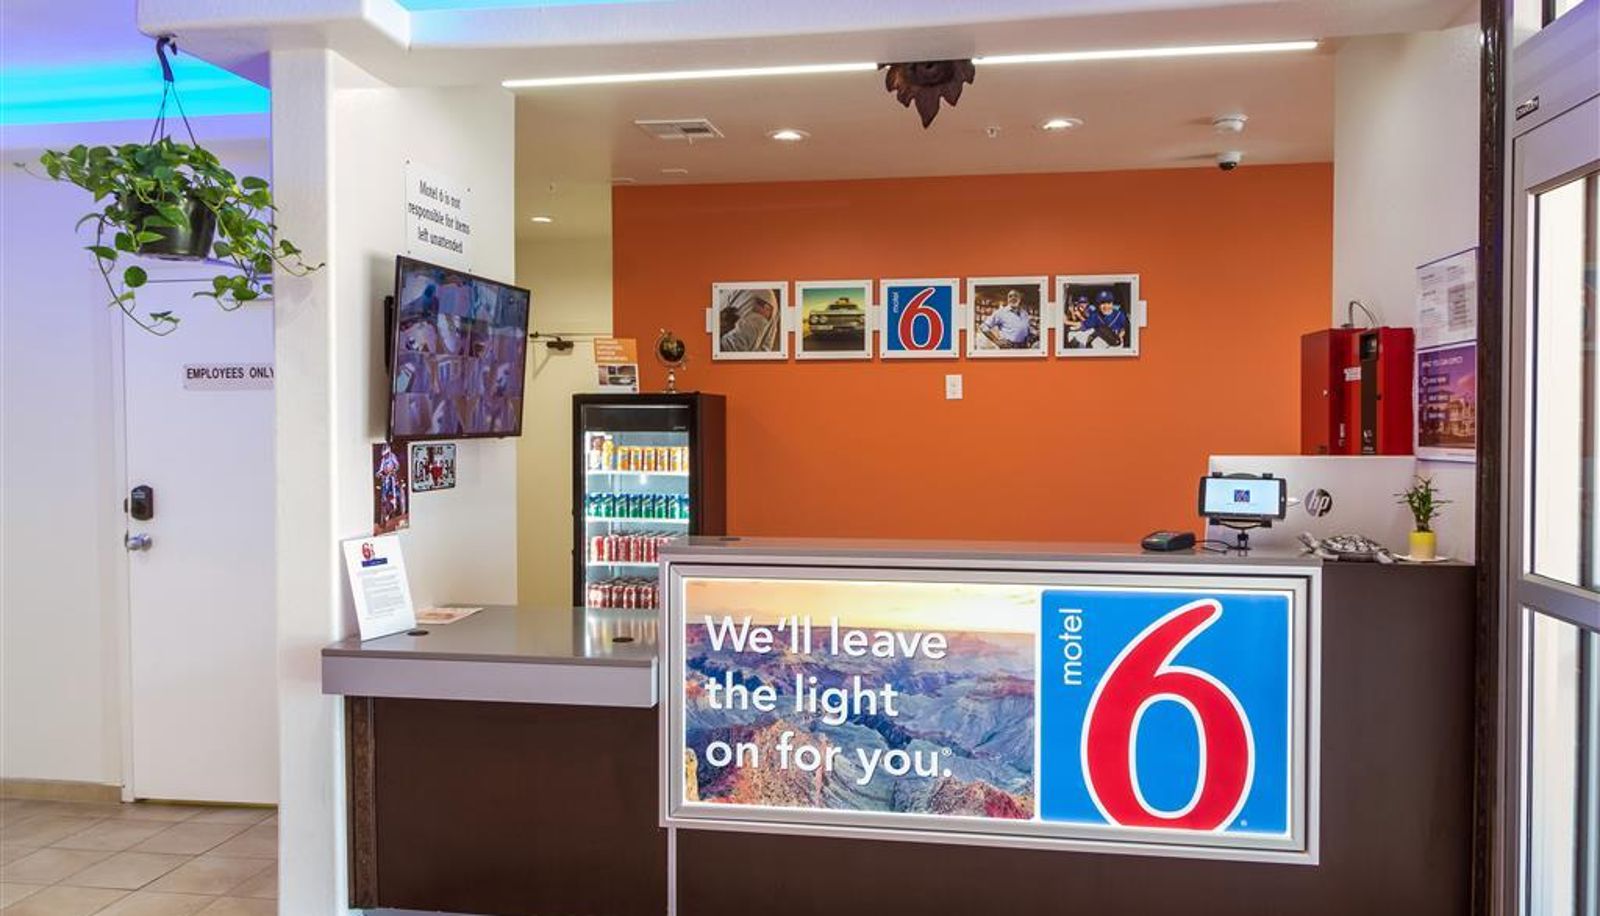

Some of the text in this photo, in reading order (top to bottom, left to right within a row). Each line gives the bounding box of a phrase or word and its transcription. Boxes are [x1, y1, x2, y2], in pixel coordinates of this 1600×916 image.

[420, 179, 461, 210] Motel 6 is not
[408, 202, 470, 235] responsible for items
[418, 226, 464, 254] left unattended
[898, 287, 944, 351] 6
[186, 367, 274, 379] EMPLOYEES ONLY
[1307, 488, 1331, 517] hp
[704, 614, 948, 660] We'll leave
[1058, 608, 1083, 686] motel
[705, 672, 899, 726] the light
[1080, 598, 1255, 832] 6
[706, 740, 759, 768] on
[777, 731, 842, 772] for
